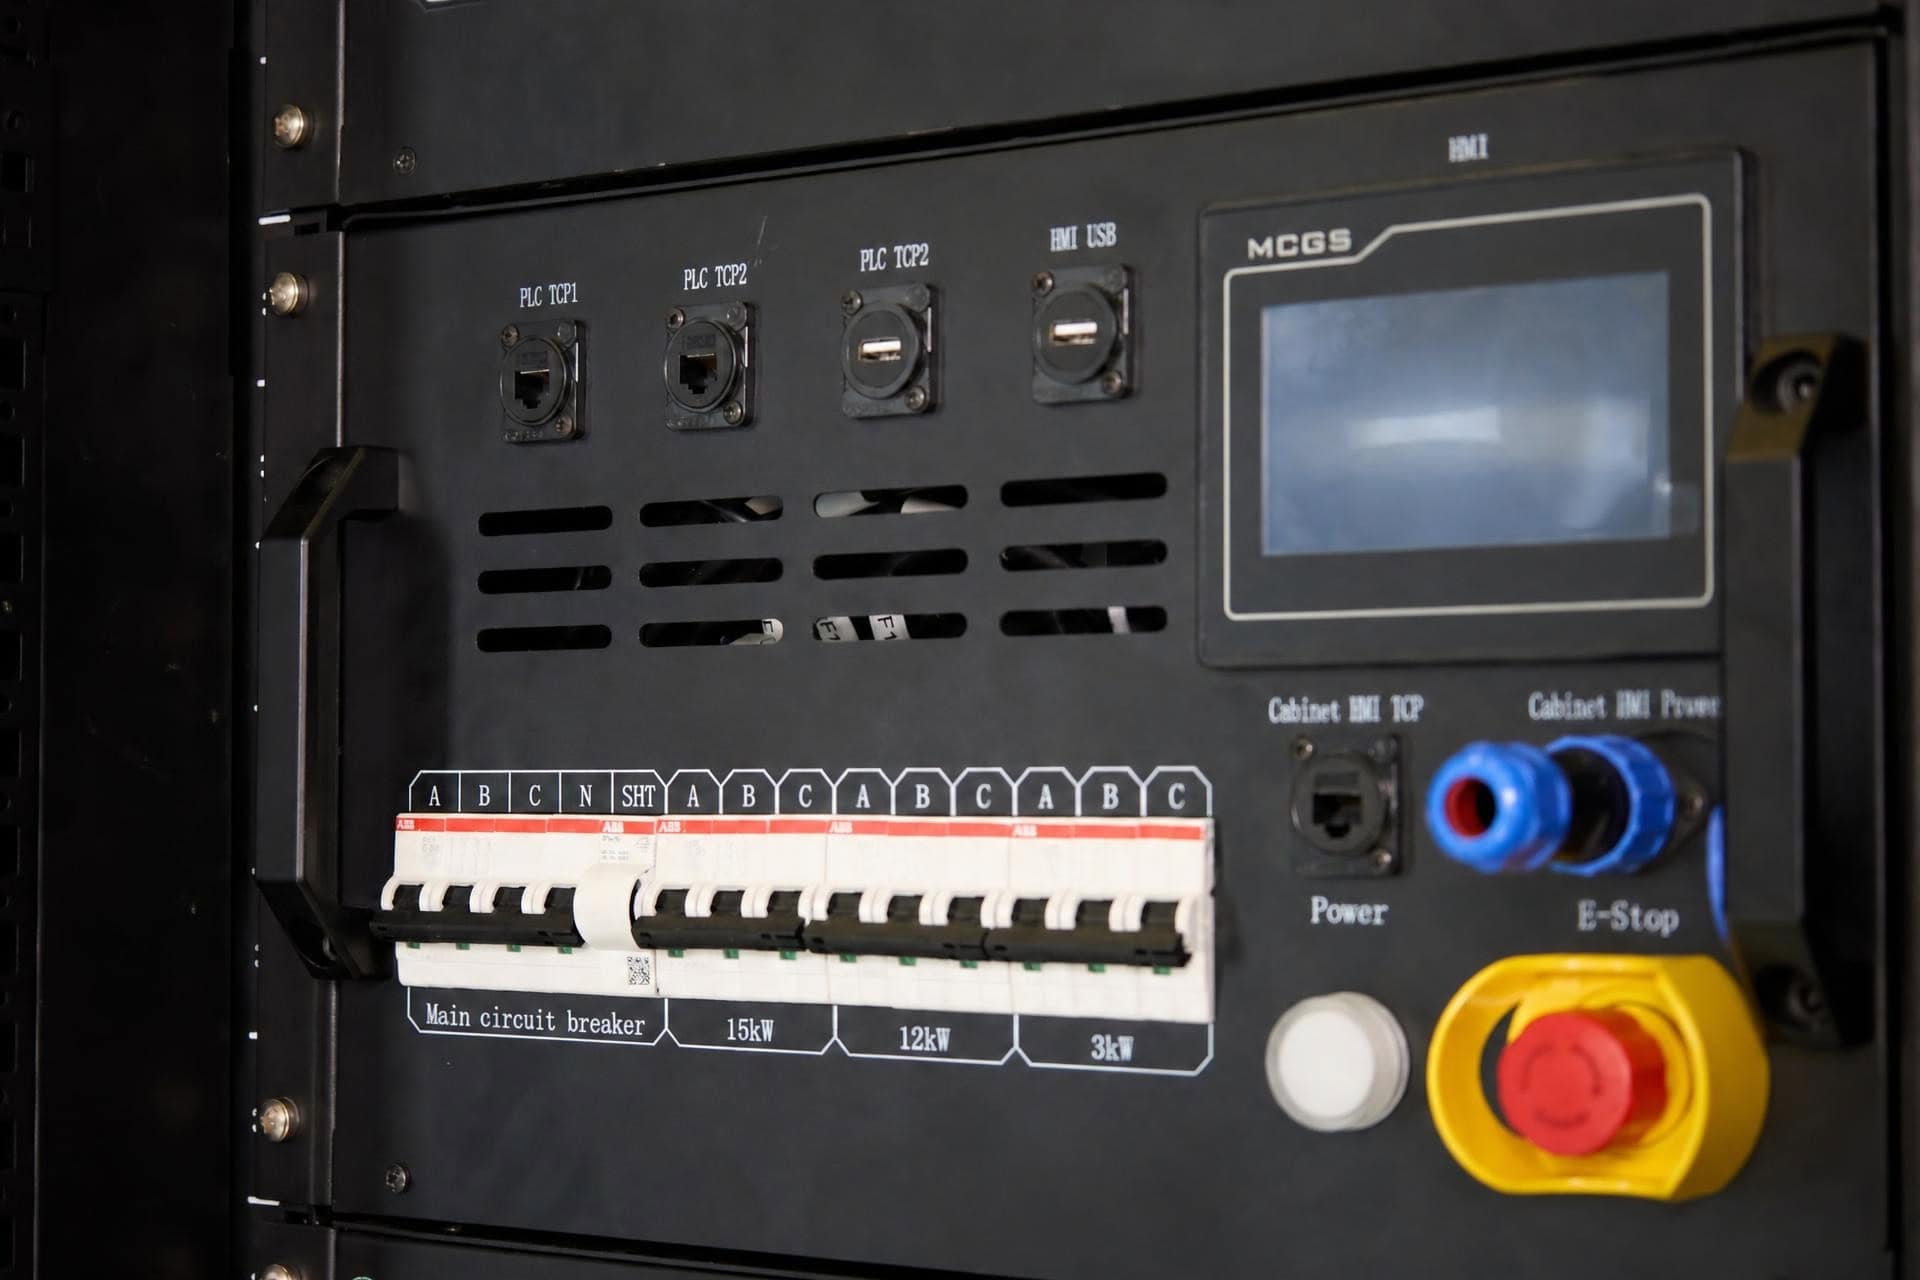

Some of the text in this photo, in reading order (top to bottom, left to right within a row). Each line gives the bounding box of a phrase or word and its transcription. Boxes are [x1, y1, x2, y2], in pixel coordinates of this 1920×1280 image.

[1449, 133, 1488, 162] HMI
[1050, 222, 1117, 252] HMI USB
[1247, 227, 1352, 261] MCGS
[860, 242, 930, 273] PLC TCP2
[683, 262, 747, 291] PLC TCP2
[519, 282, 578, 308] PLC TCP1
[1268, 694, 1424, 725] Cabinet HMI TCP
[1528, 689, 1721, 720] Cabinet HMI Power
[428, 784, 657, 808] A B C N SHT
[686, 784, 812, 808] A B C
[855, 784, 992, 810] A B C
[1037, 784, 1186, 810] A B C
[396, 819, 415, 830] ABB
[602, 821, 624, 833] ABB
[658, 821, 681, 832] ABB
[1310, 895, 1390, 926] Power
[1577, 898, 1681, 939] E-Stop
[426, 1002, 646, 1036] Main circuit breaker
[727, 1017, 775, 1042] 15kW
[899, 1025, 951, 1052] 12kW
[1091, 1034, 1134, 1062] 3kW
